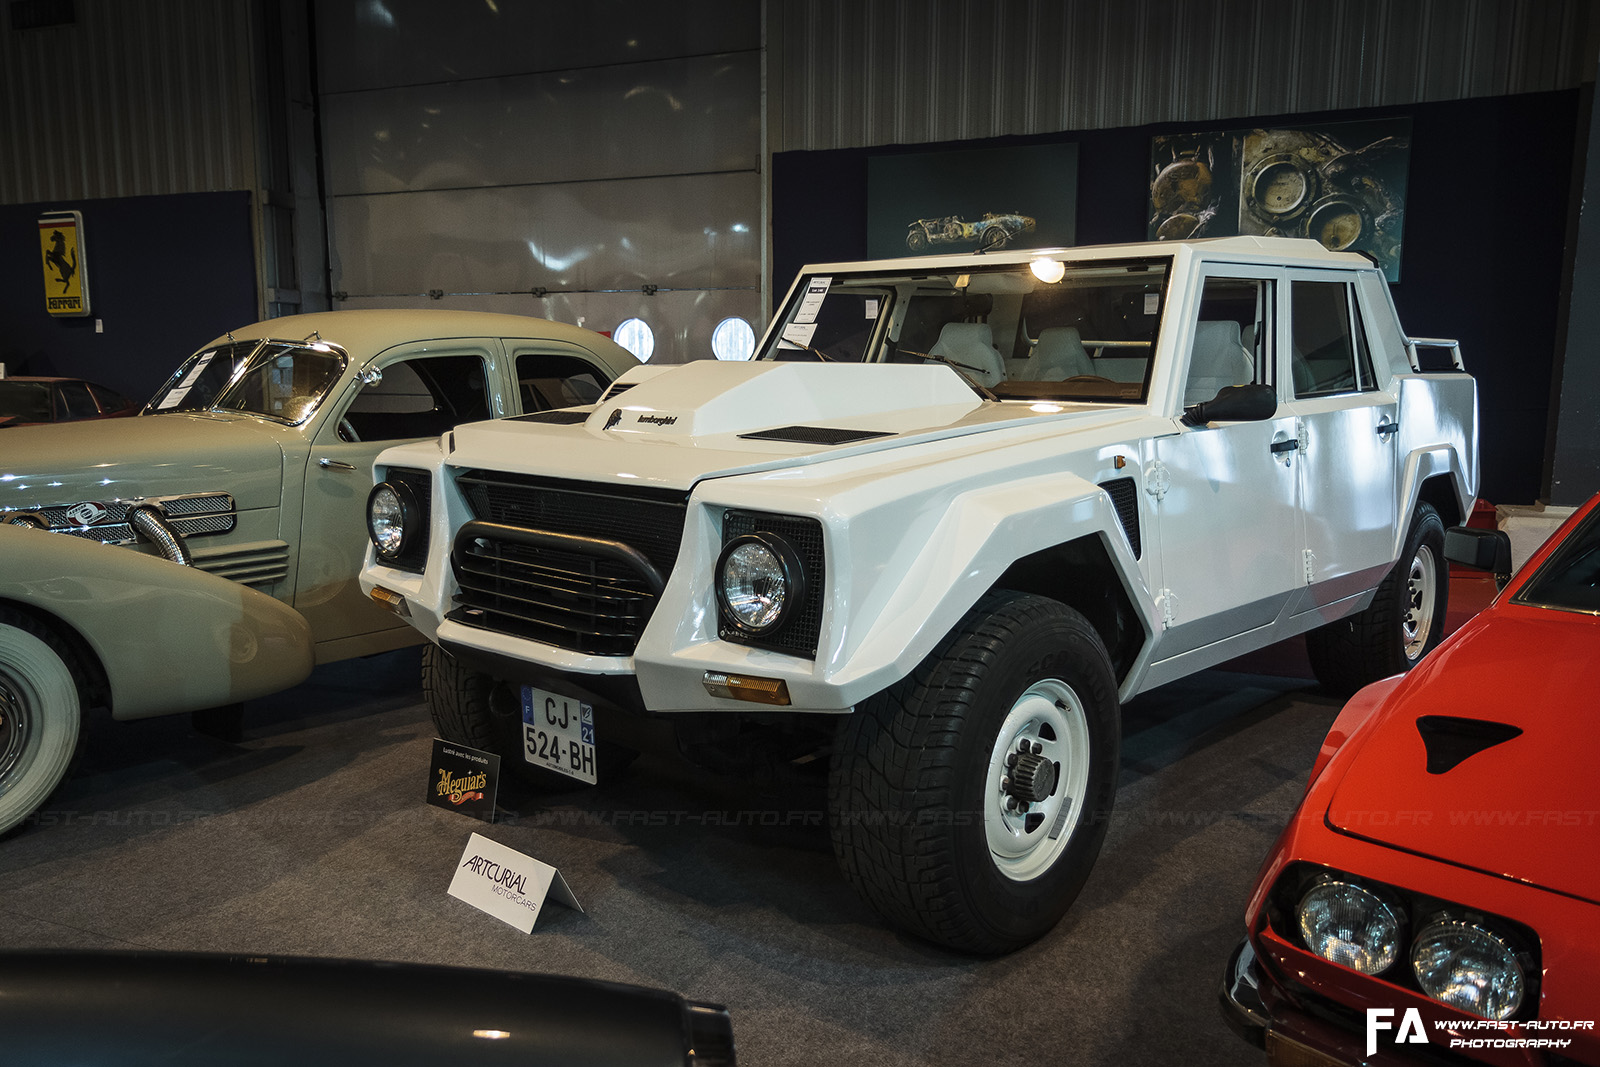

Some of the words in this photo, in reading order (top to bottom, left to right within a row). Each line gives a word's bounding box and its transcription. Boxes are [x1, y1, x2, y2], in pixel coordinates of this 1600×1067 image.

[48, 296, 82, 310] Ferrari
[525, 705, 530, 714] F
[582, 726, 595, 744] 21
[526, 726, 595, 777] 524-BH
[436, 768, 487, 803] Meguiar's
[491, 884, 537, 912] MOTORCARS
